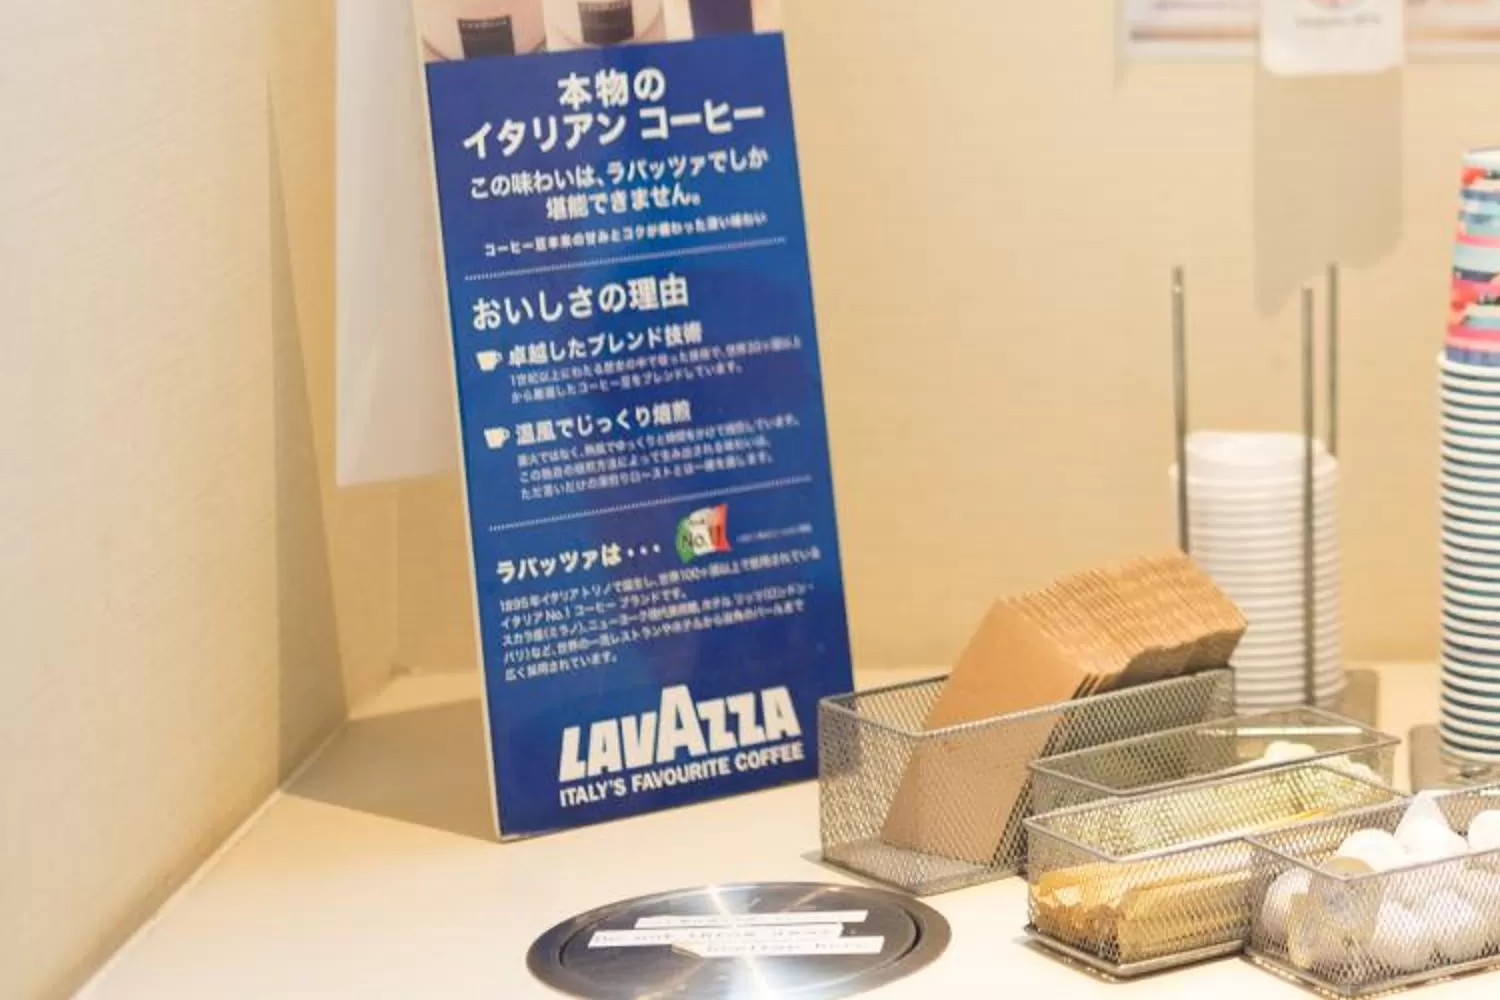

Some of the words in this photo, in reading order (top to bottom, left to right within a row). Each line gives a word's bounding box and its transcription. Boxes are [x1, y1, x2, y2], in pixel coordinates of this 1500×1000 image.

[557, 68, 666, 110] 本物の
[462, 112, 627, 159] イタリアン
[639, 99, 766, 140] コーヒー
[545, 185, 701, 221] 堪能できません。
[471, 274, 689, 331] おいしさの理由
[559, 684, 804, 782] LAVAZZA
[560, 777, 627, 808] ITALY'S
[631, 758, 731, 793] FAVOURITE
[734, 743, 804, 772] COFFEE
